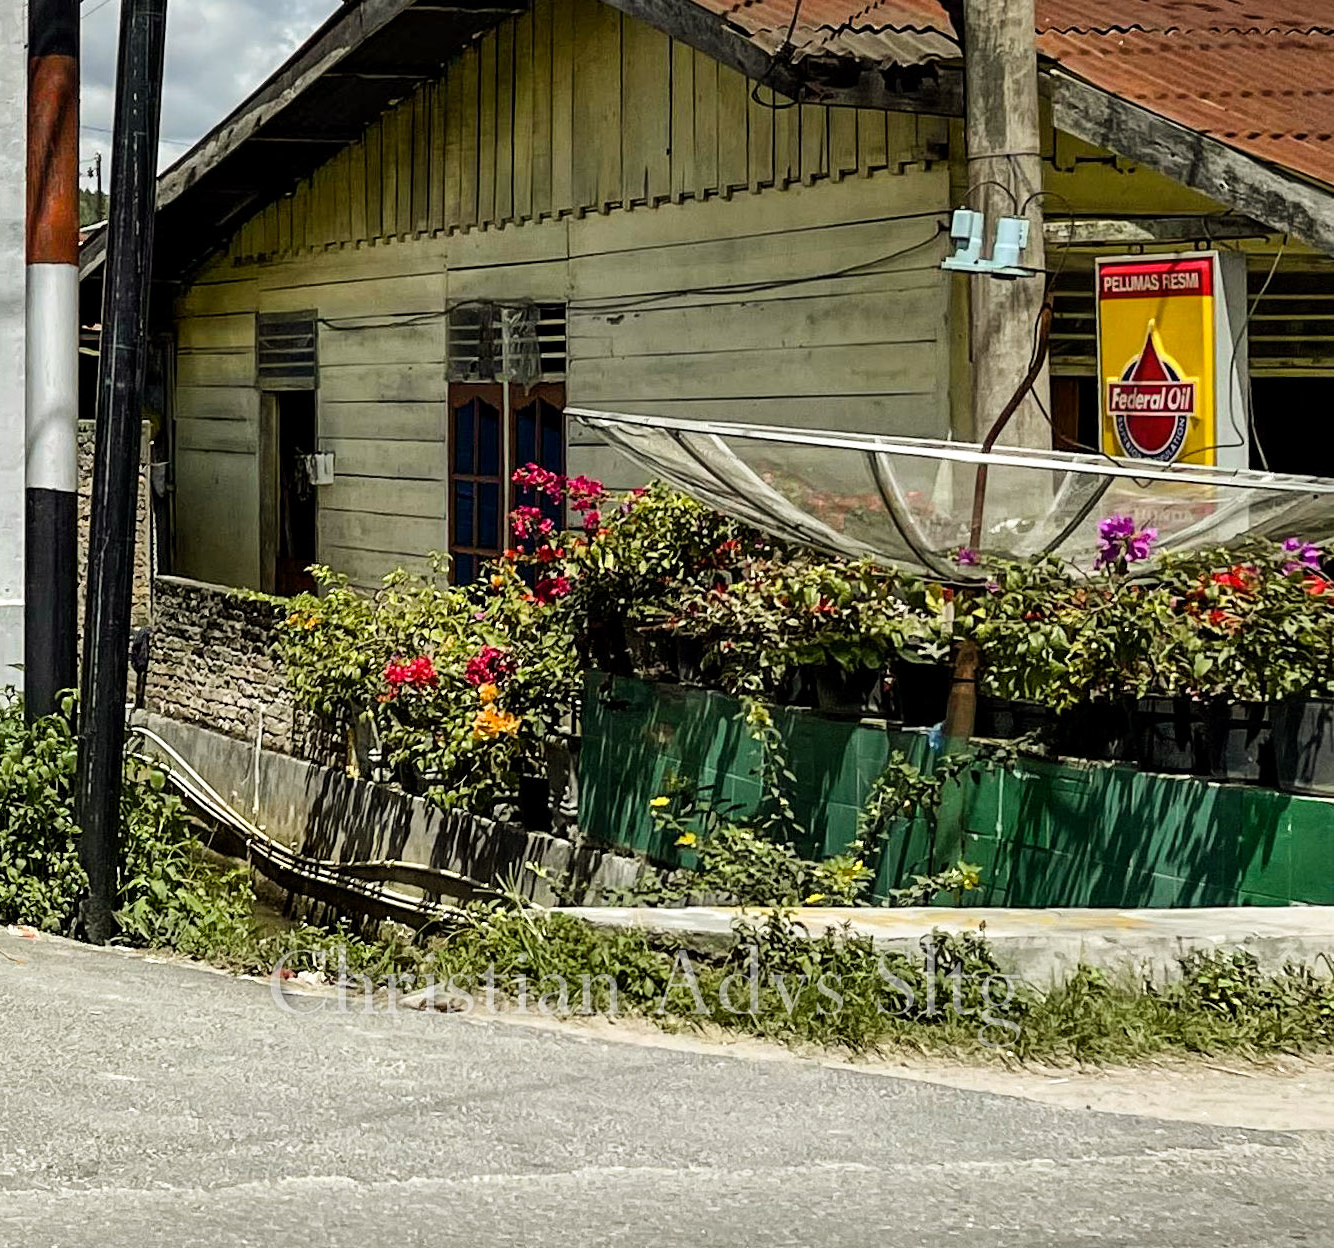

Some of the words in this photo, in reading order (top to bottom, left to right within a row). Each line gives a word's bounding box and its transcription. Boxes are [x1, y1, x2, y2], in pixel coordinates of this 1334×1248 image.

[1103, 274, 1160, 292] PELUMAS
[1162, 272, 1199, 290] RESMI
[1111, 386, 1166, 410] Federal
[1167, 386, 1192, 411] Oil
